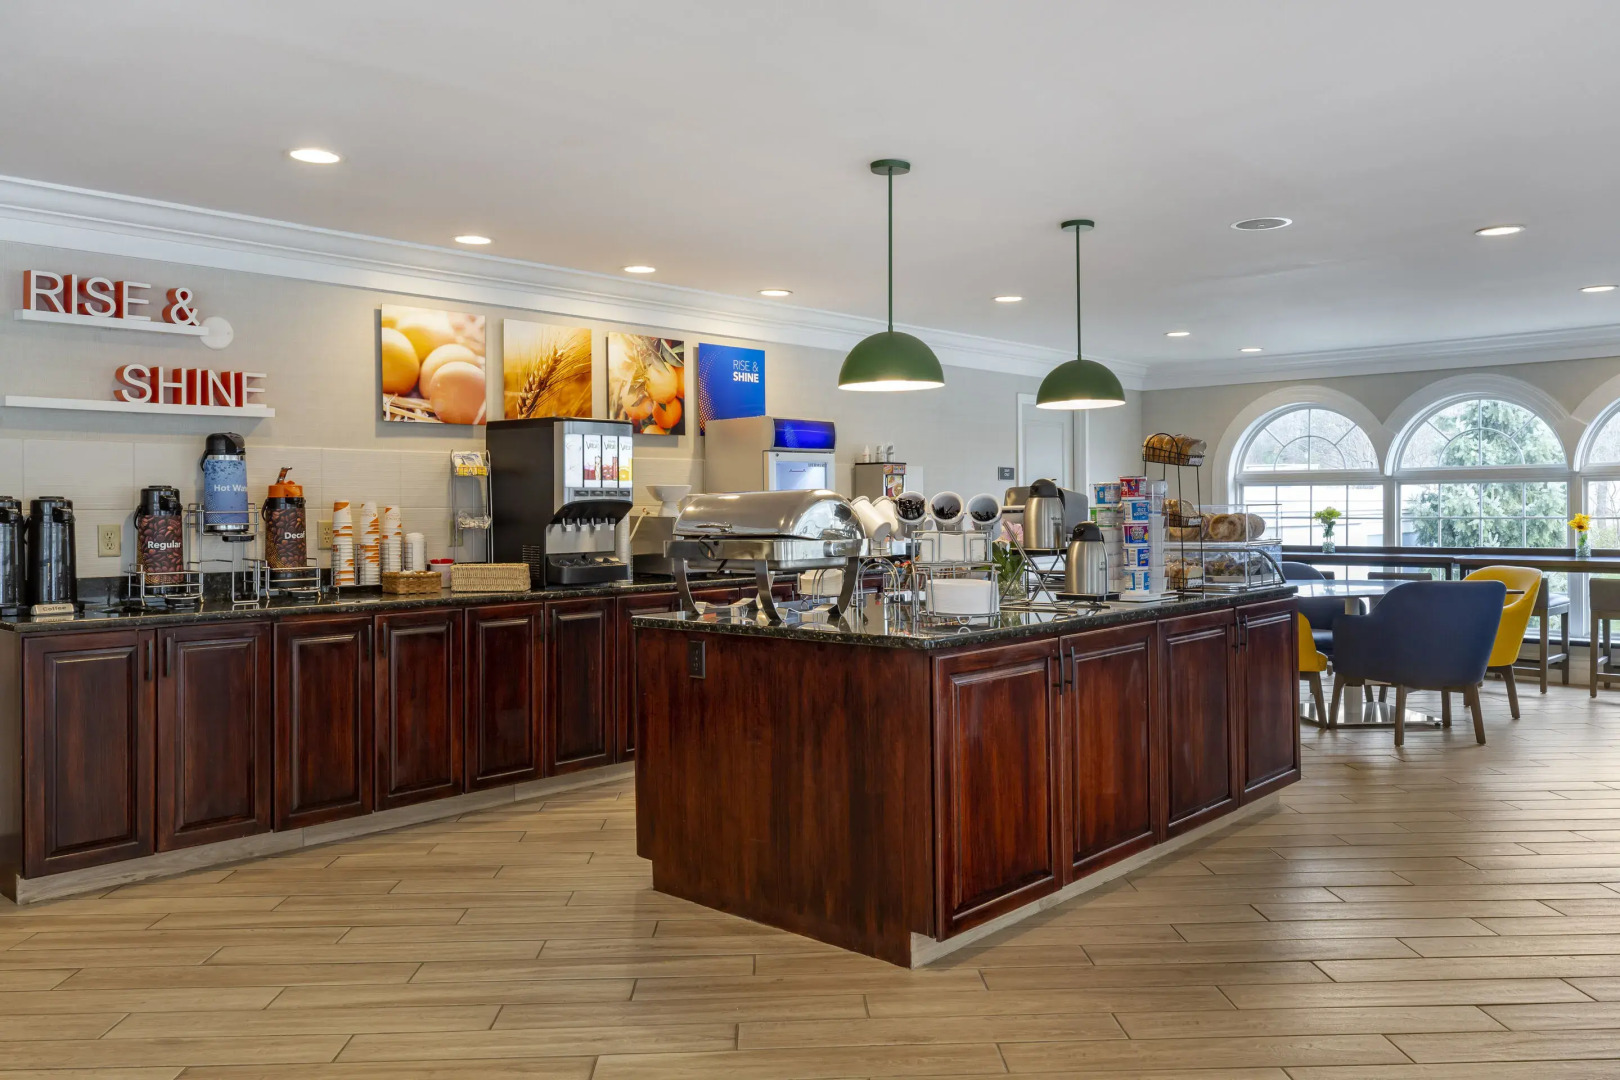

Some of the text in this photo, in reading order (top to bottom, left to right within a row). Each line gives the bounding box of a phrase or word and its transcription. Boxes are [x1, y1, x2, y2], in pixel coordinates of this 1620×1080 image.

[23, 269, 200, 326] RISE &
[733, 360, 759, 372] RISE &
[733, 371, 759, 383] SHINE
[113, 363, 267, 408] SHINE
[213, 484, 231, 492] Hot
[284, 530, 305, 540] Decaf
[147, 540, 181, 551] Regular
